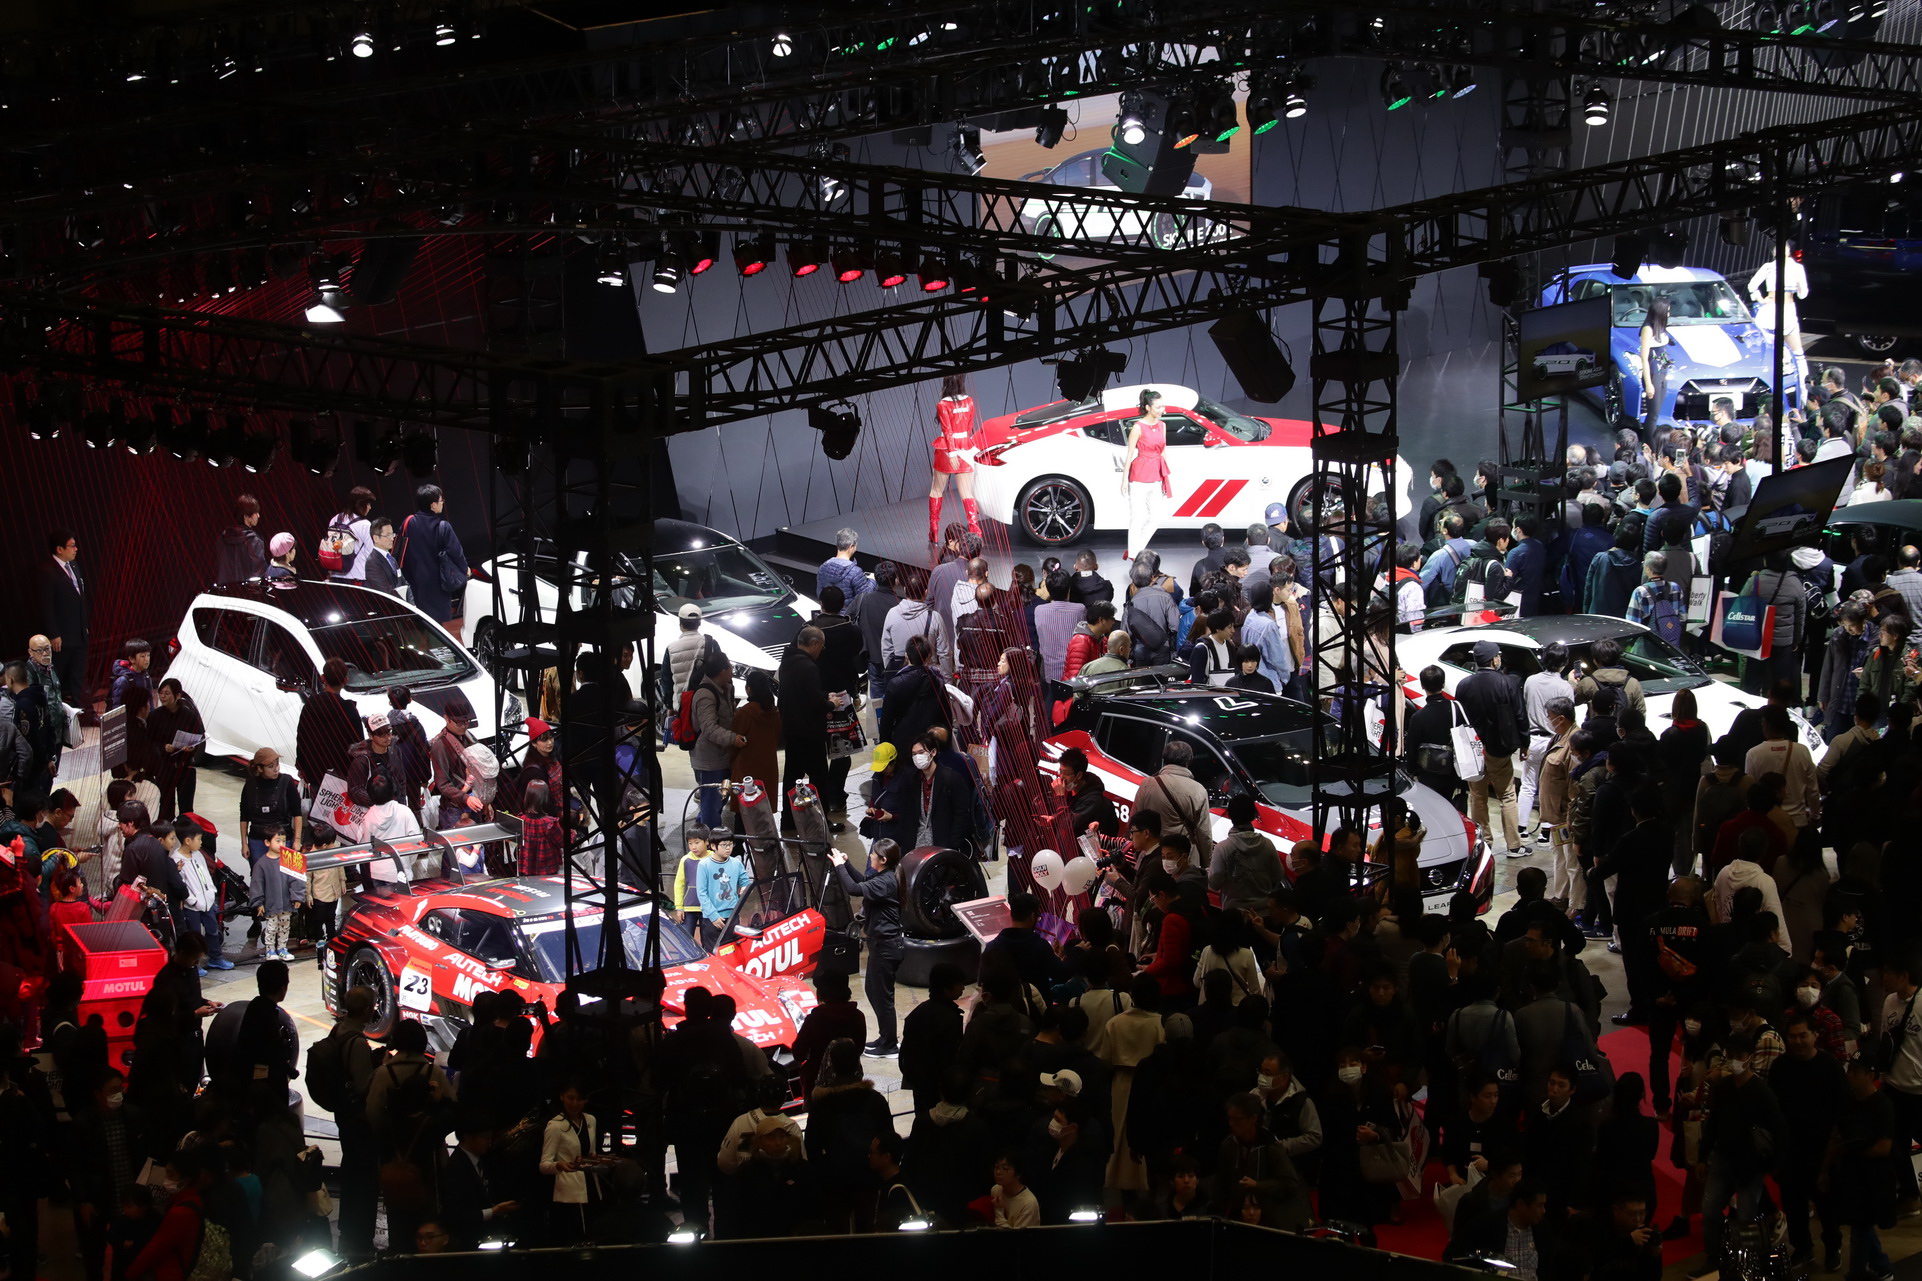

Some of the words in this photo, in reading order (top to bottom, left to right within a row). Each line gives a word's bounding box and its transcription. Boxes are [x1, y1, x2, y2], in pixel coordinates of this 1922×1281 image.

[750, 913, 811, 953] AUTECH
[103, 981, 145, 994] MOTUL
[404, 975, 428, 995] 23
